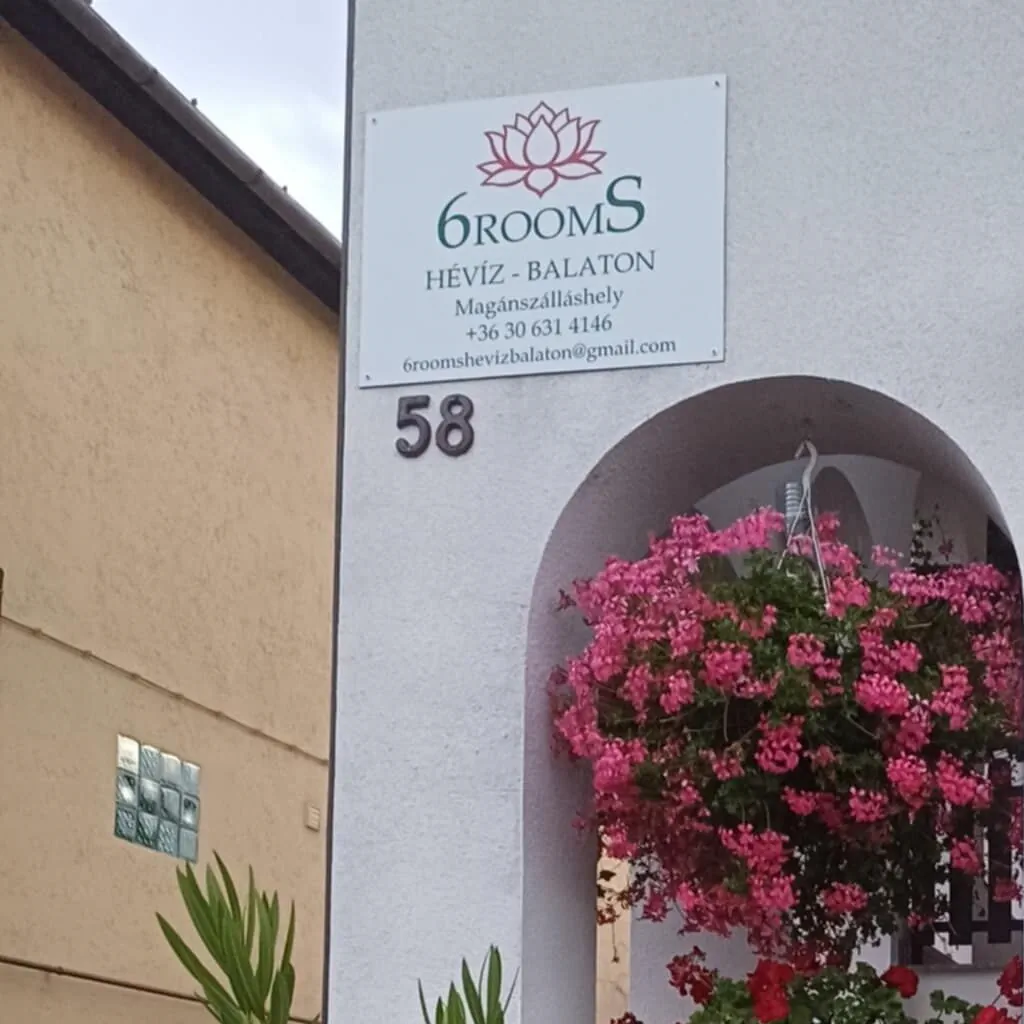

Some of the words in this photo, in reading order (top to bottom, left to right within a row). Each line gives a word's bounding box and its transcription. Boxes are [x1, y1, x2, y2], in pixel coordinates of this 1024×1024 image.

[425, 262, 505, 290] HÉVÍZ
[527, 250, 656, 282] BALATON
[455, 287, 624, 319] Magánszálláshely
[466, 324, 499, 342] +36
[504, 321, 526, 339] 30
[531, 319, 562, 337] 631
[568, 315, 612, 334] 4146
[395, 393, 475, 458] 58
